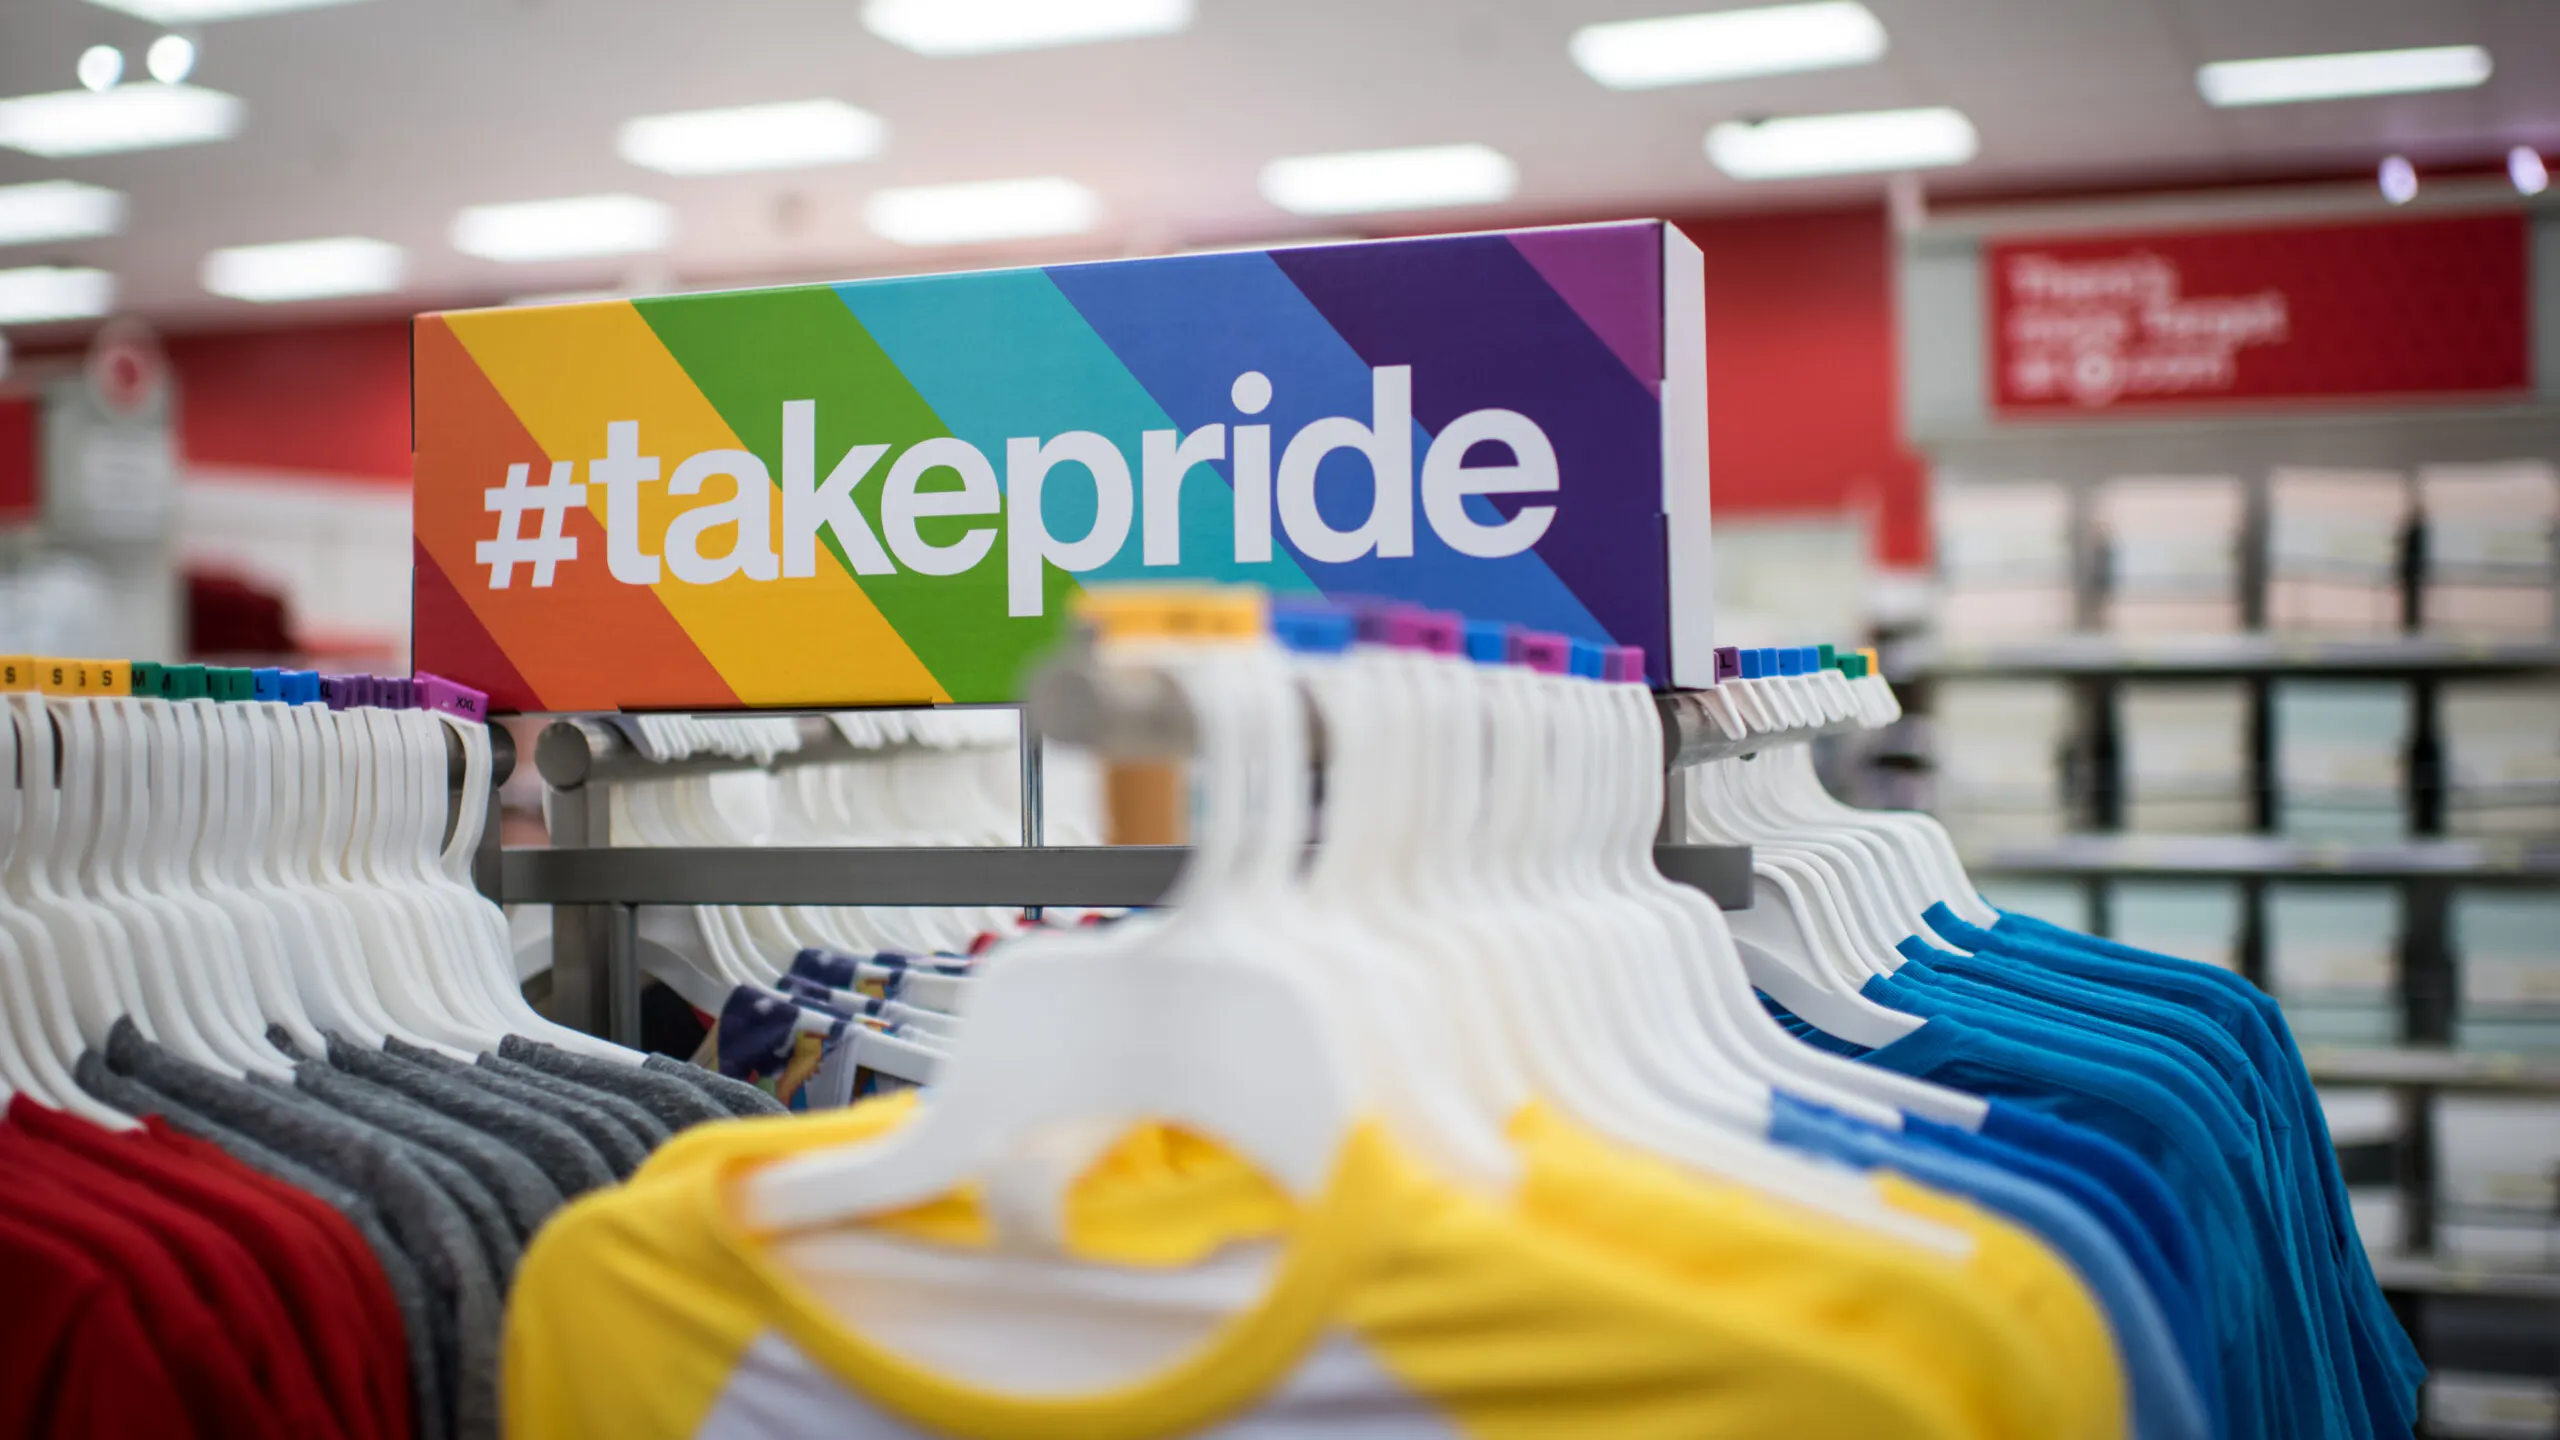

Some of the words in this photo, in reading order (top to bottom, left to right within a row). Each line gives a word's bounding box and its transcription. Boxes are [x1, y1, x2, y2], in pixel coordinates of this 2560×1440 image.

[474, 364, 1560, 617] #takepride
[5, 666, 16, 685] S
[53, 668, 63, 685] S
[102, 670, 113, 687] S
[131, 670, 146, 688] M
[255, 677, 265, 693] L
[456, 697, 476, 713] XXL
